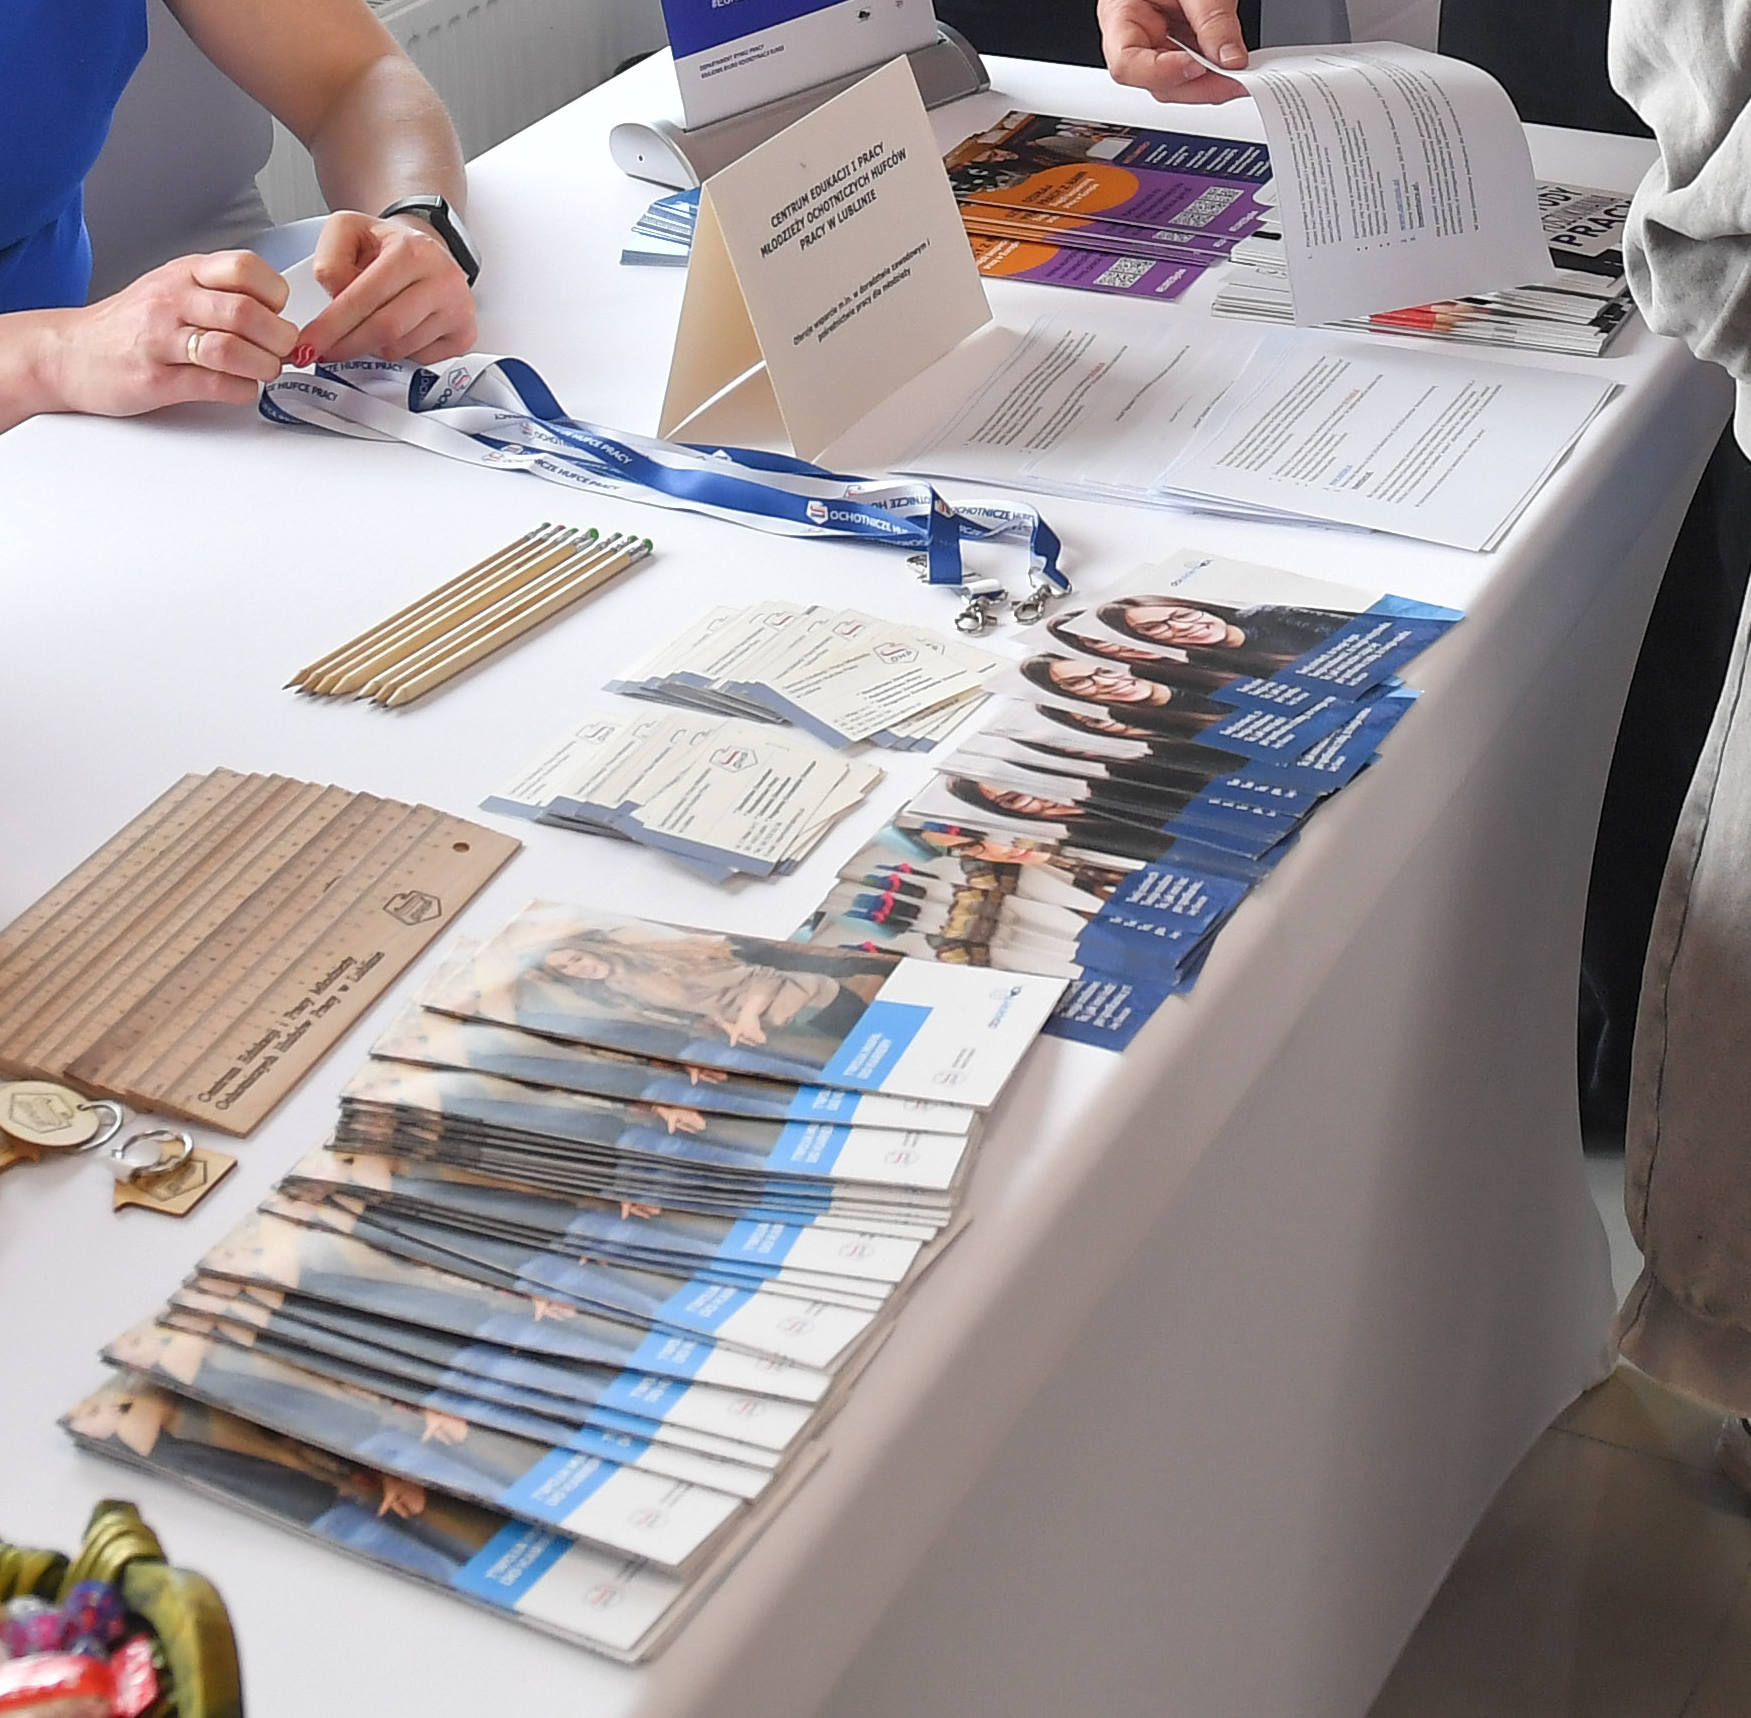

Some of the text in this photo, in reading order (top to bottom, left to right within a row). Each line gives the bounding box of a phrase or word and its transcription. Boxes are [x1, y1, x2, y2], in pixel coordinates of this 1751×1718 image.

[771, 193, 809, 228] CENTRUM
[810, 165, 851, 200] EDUKACJI
[857, 142, 885, 168] PRACY
[760, 148, 907, 258] MŁODZIEŻY OCHOTNICZYCH HUFCÓW
[800, 189, 878, 251] PRACY W LUBLINIE
[375, 361, 403, 373] PRACY
[278, 382, 310, 393] HUFCE
[311, 386, 339, 402] PRACY
[601, 443, 633, 464] PRACY
[830, 510, 892, 533] OCHOTNICZE
[951, 506, 1011, 521] OCHOTNICZE
